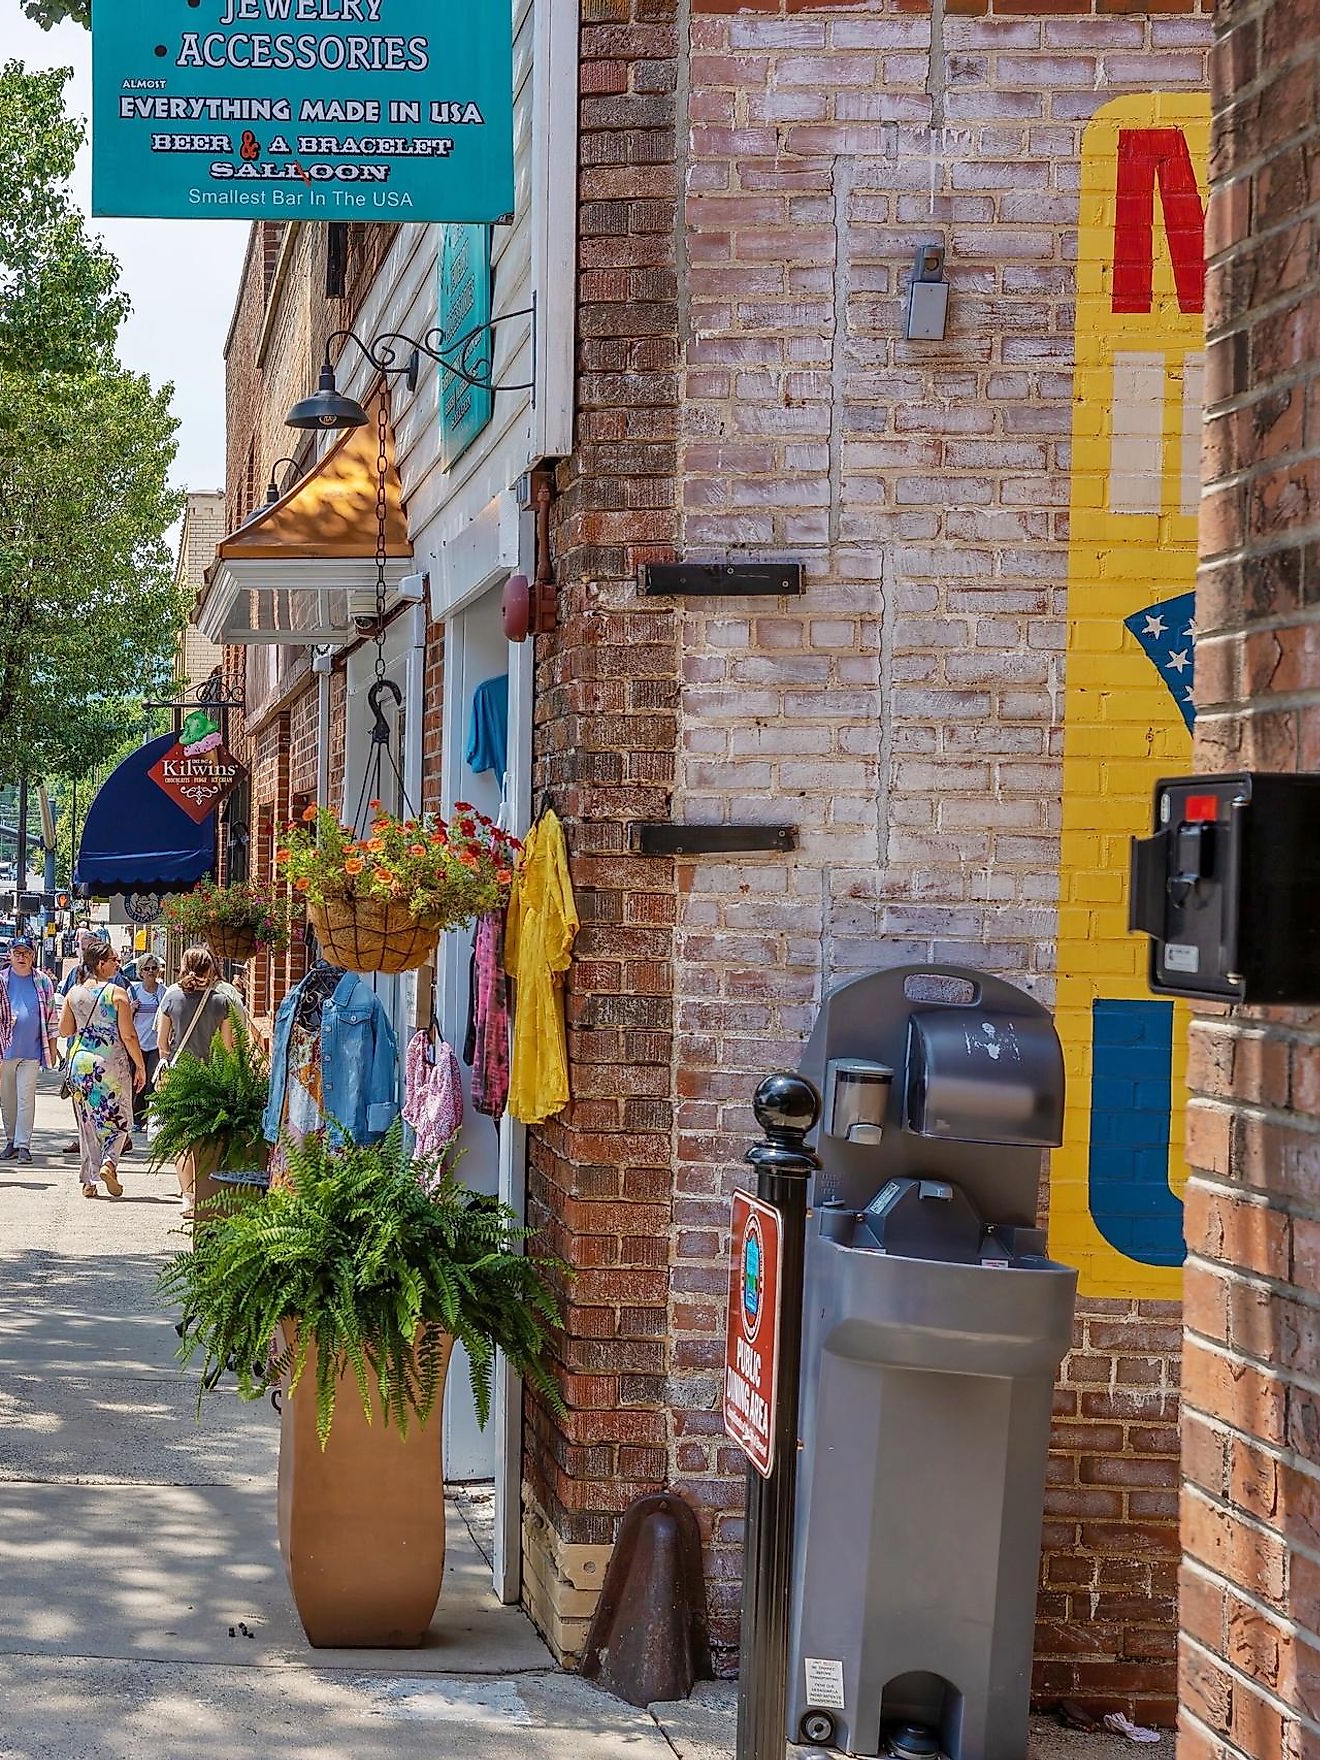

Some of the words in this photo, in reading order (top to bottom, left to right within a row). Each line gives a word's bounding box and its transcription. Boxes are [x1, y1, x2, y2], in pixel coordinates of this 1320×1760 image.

[220, 0, 382, 24] JEWELRY
[177, 33, 429, 71] ACCESSORIES
[122, 79, 166, 89] ALMOST
[120, 97, 291, 122] EVERYTHING
[299, 100, 380, 122] MADE
[390, 102, 420, 123] IN
[431, 102, 485, 124] USA
[151, 133, 232, 153] BEER
[240, 131, 260, 159] &
[269, 136, 291, 154] A
[298, 137, 453, 157] BRACELET
[189, 188, 266, 205] Smallest
[272, 190, 302, 206] Bar
[310, 191, 326, 206] In
[332, 191, 365, 207] The
[373, 191, 413, 207] USA
[163, 760, 236, 776] Kilwins
[736, 1336, 762, 1390] PUBLIC
[749, 1389, 768, 1439] AREA
